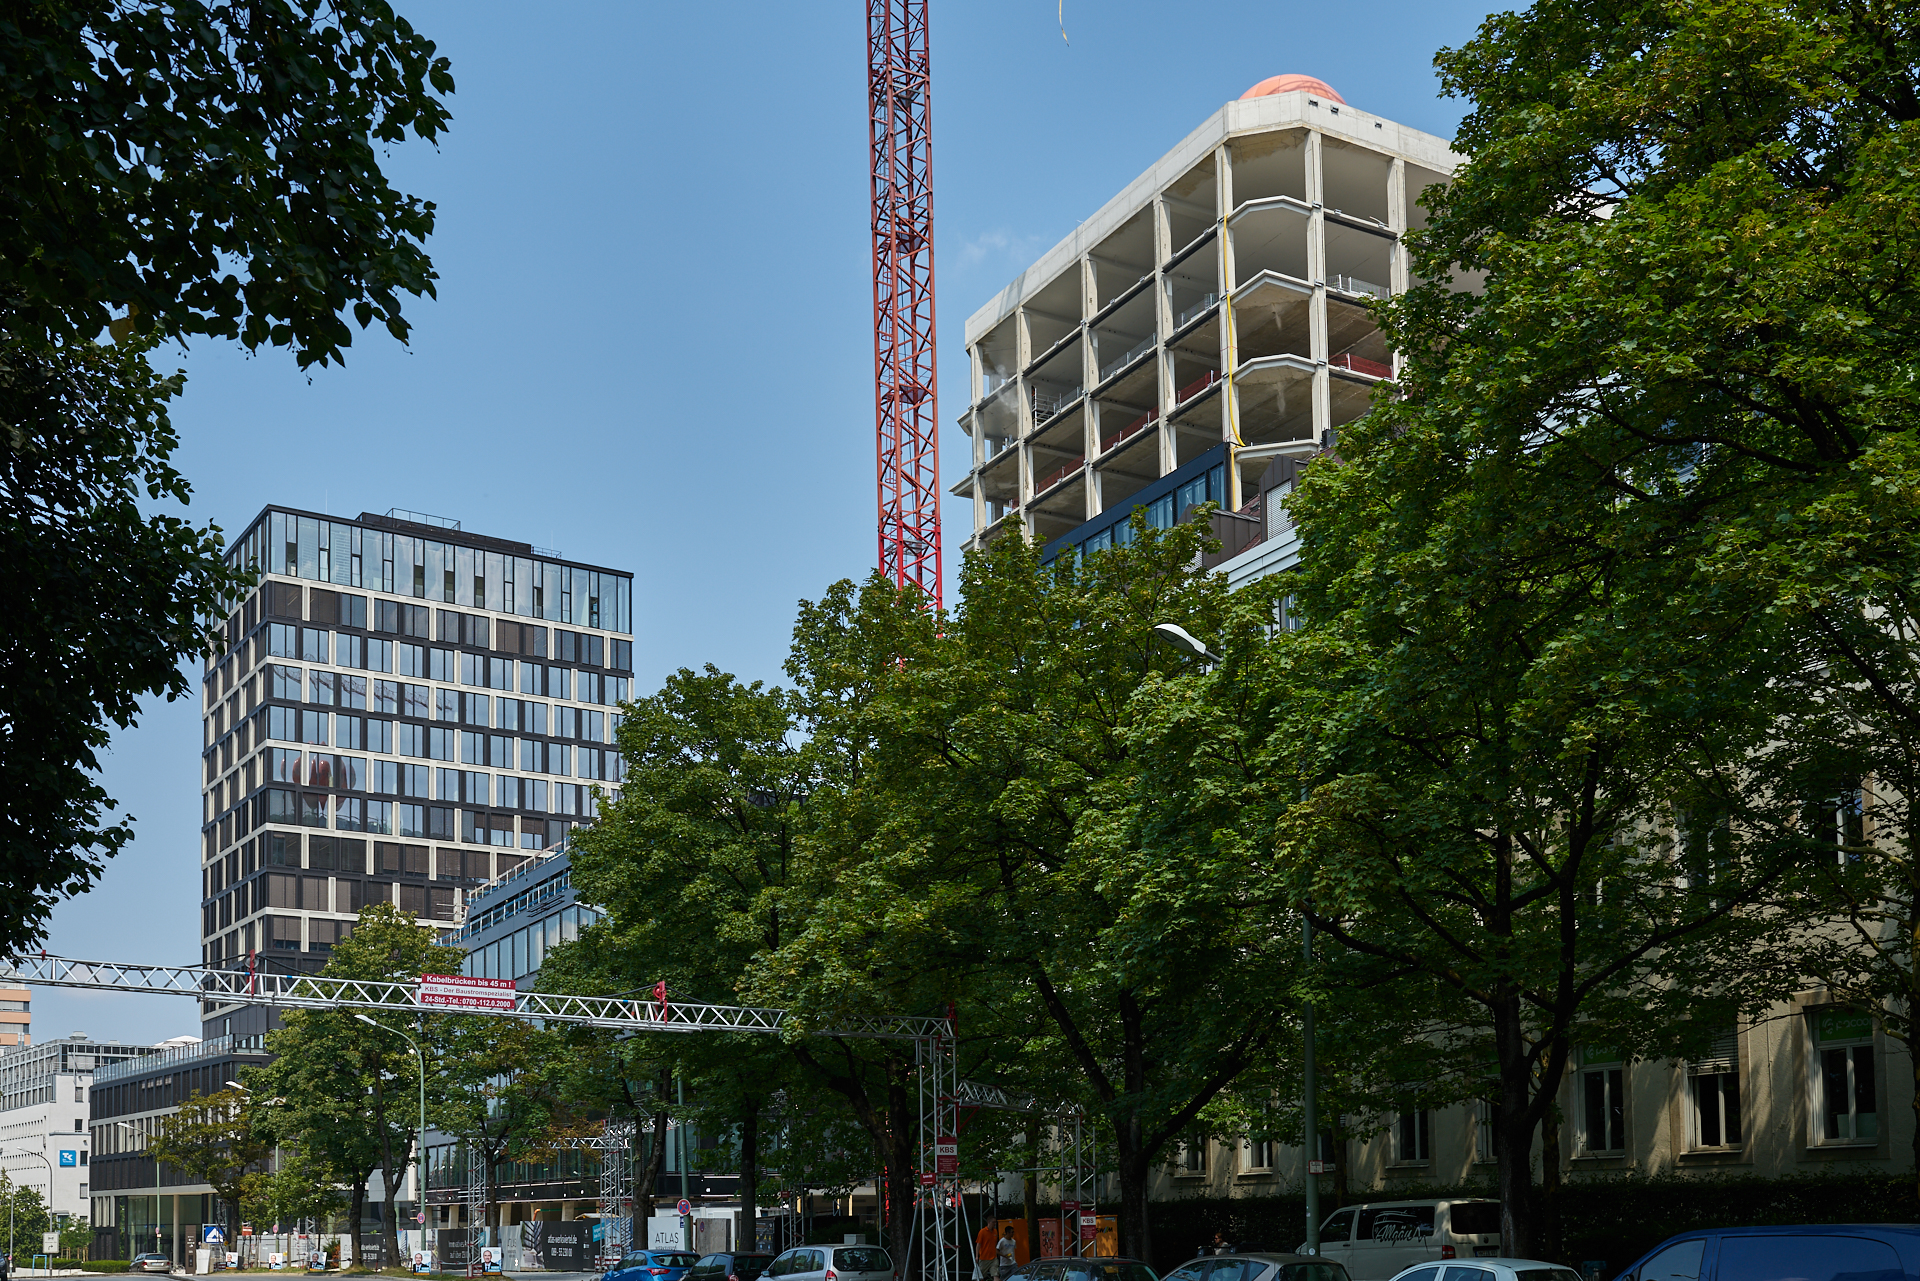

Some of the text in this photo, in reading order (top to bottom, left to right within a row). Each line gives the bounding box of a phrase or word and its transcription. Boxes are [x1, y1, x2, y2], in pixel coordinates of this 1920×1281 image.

[427, 976, 476, 986] Kabelbrücken
[456, 988, 511, 997] Baustromspezialist
[655, 1232, 679, 1243] ATLAS
